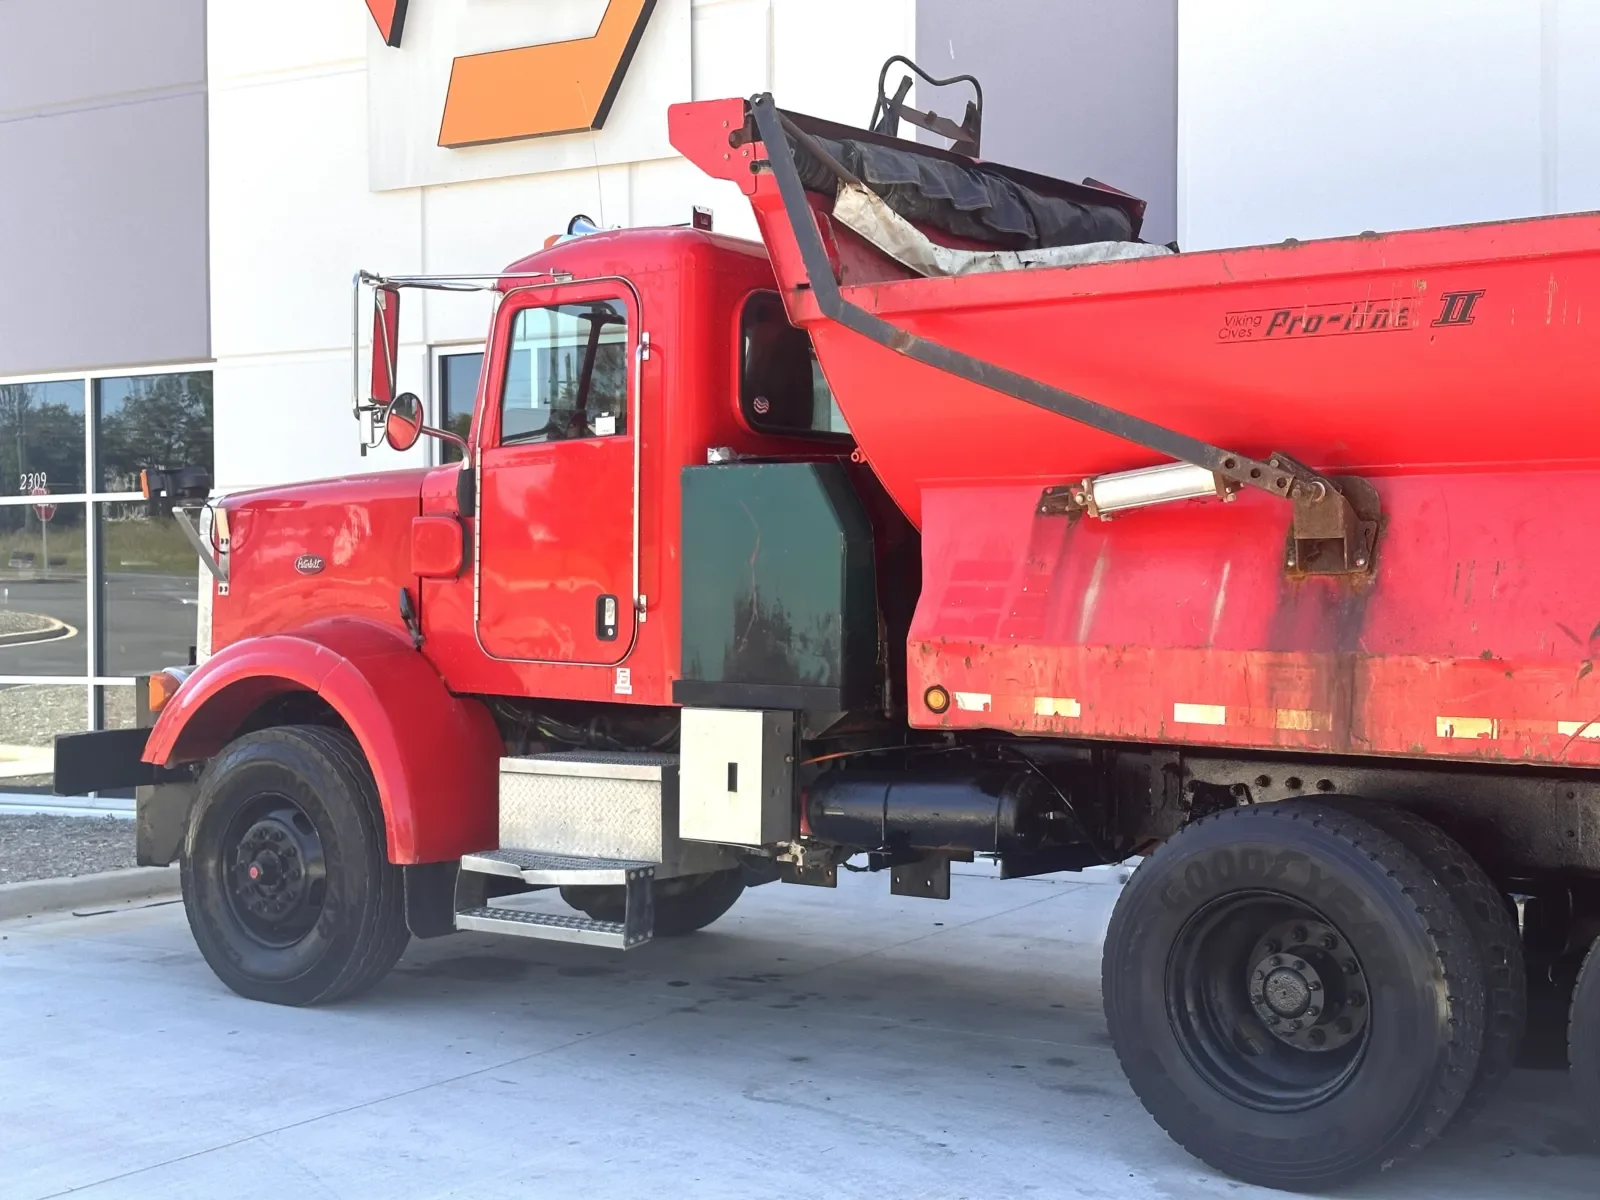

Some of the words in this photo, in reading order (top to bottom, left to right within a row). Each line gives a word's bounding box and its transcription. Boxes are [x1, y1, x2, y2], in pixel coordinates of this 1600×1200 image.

[1430, 289, 1487, 328] II
[1225, 314, 1262, 327] Viking
[1218, 327, 1252, 339] Cives
[20, 472, 47, 490] 2309
